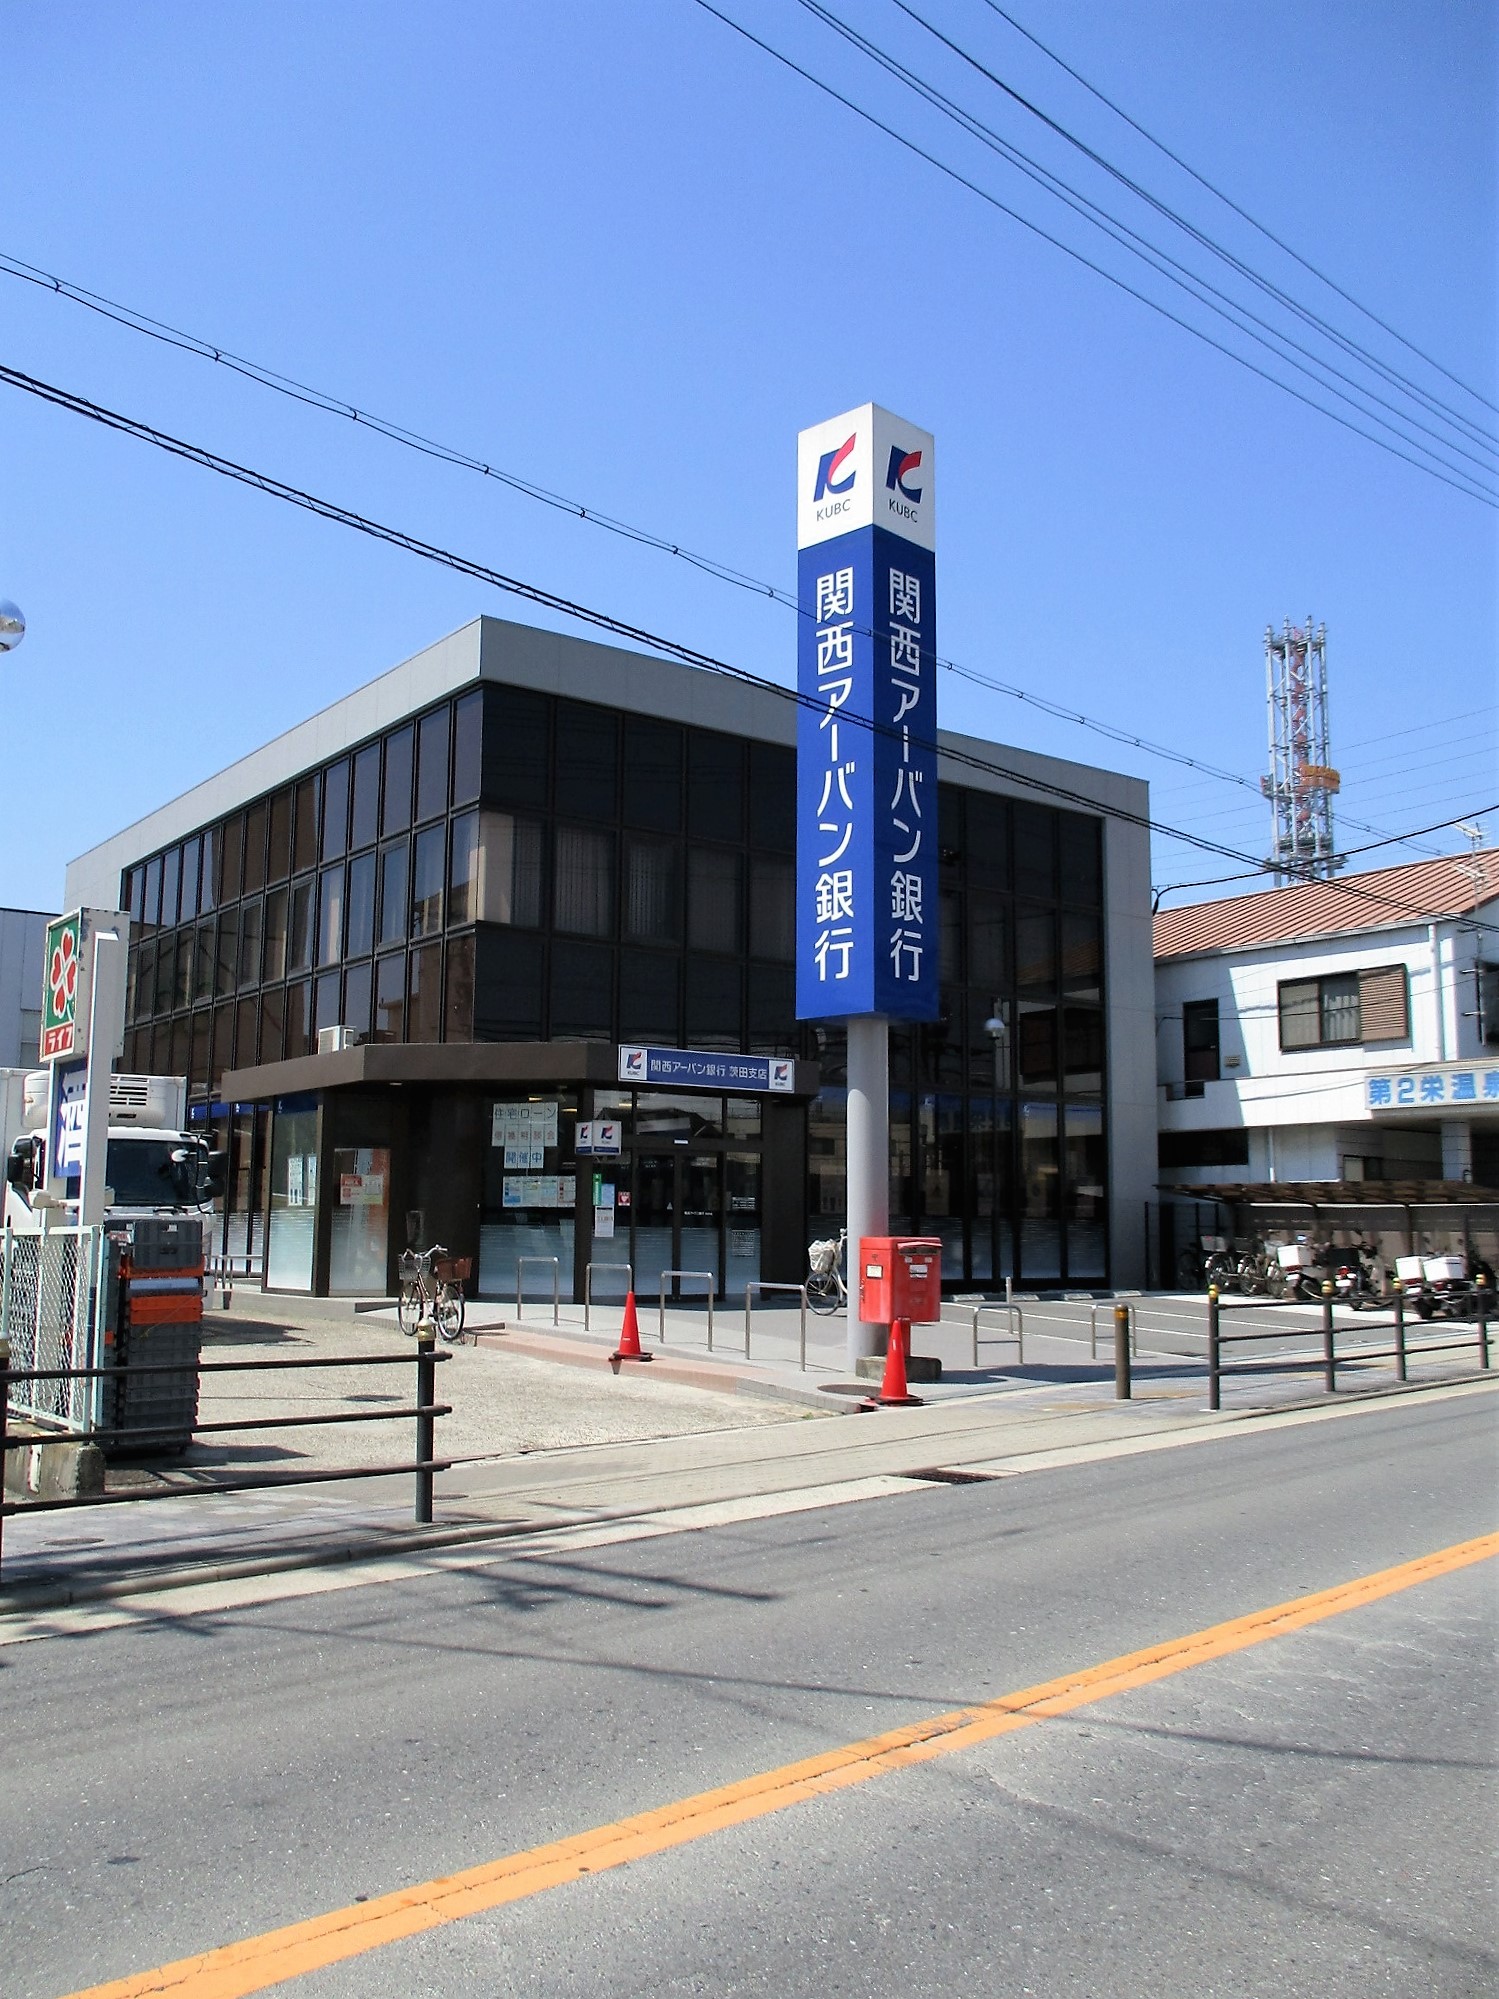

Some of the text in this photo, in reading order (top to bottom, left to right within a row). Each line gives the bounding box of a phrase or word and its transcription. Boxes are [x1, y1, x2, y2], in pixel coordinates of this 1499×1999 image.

[816, 499, 851, 522] KUBC
[889, 498, 918, 523] KUBC
[814, 565, 854, 981] 関西アーバン銀行
[890, 567, 923, 982] 関西アーバン銀行
[48, 1027, 73, 1052] ライフ
[650, 1059, 768, 1081] 関西アーバン銀行 茨田支店
[495, 1107, 556, 1120] 住宅ローン
